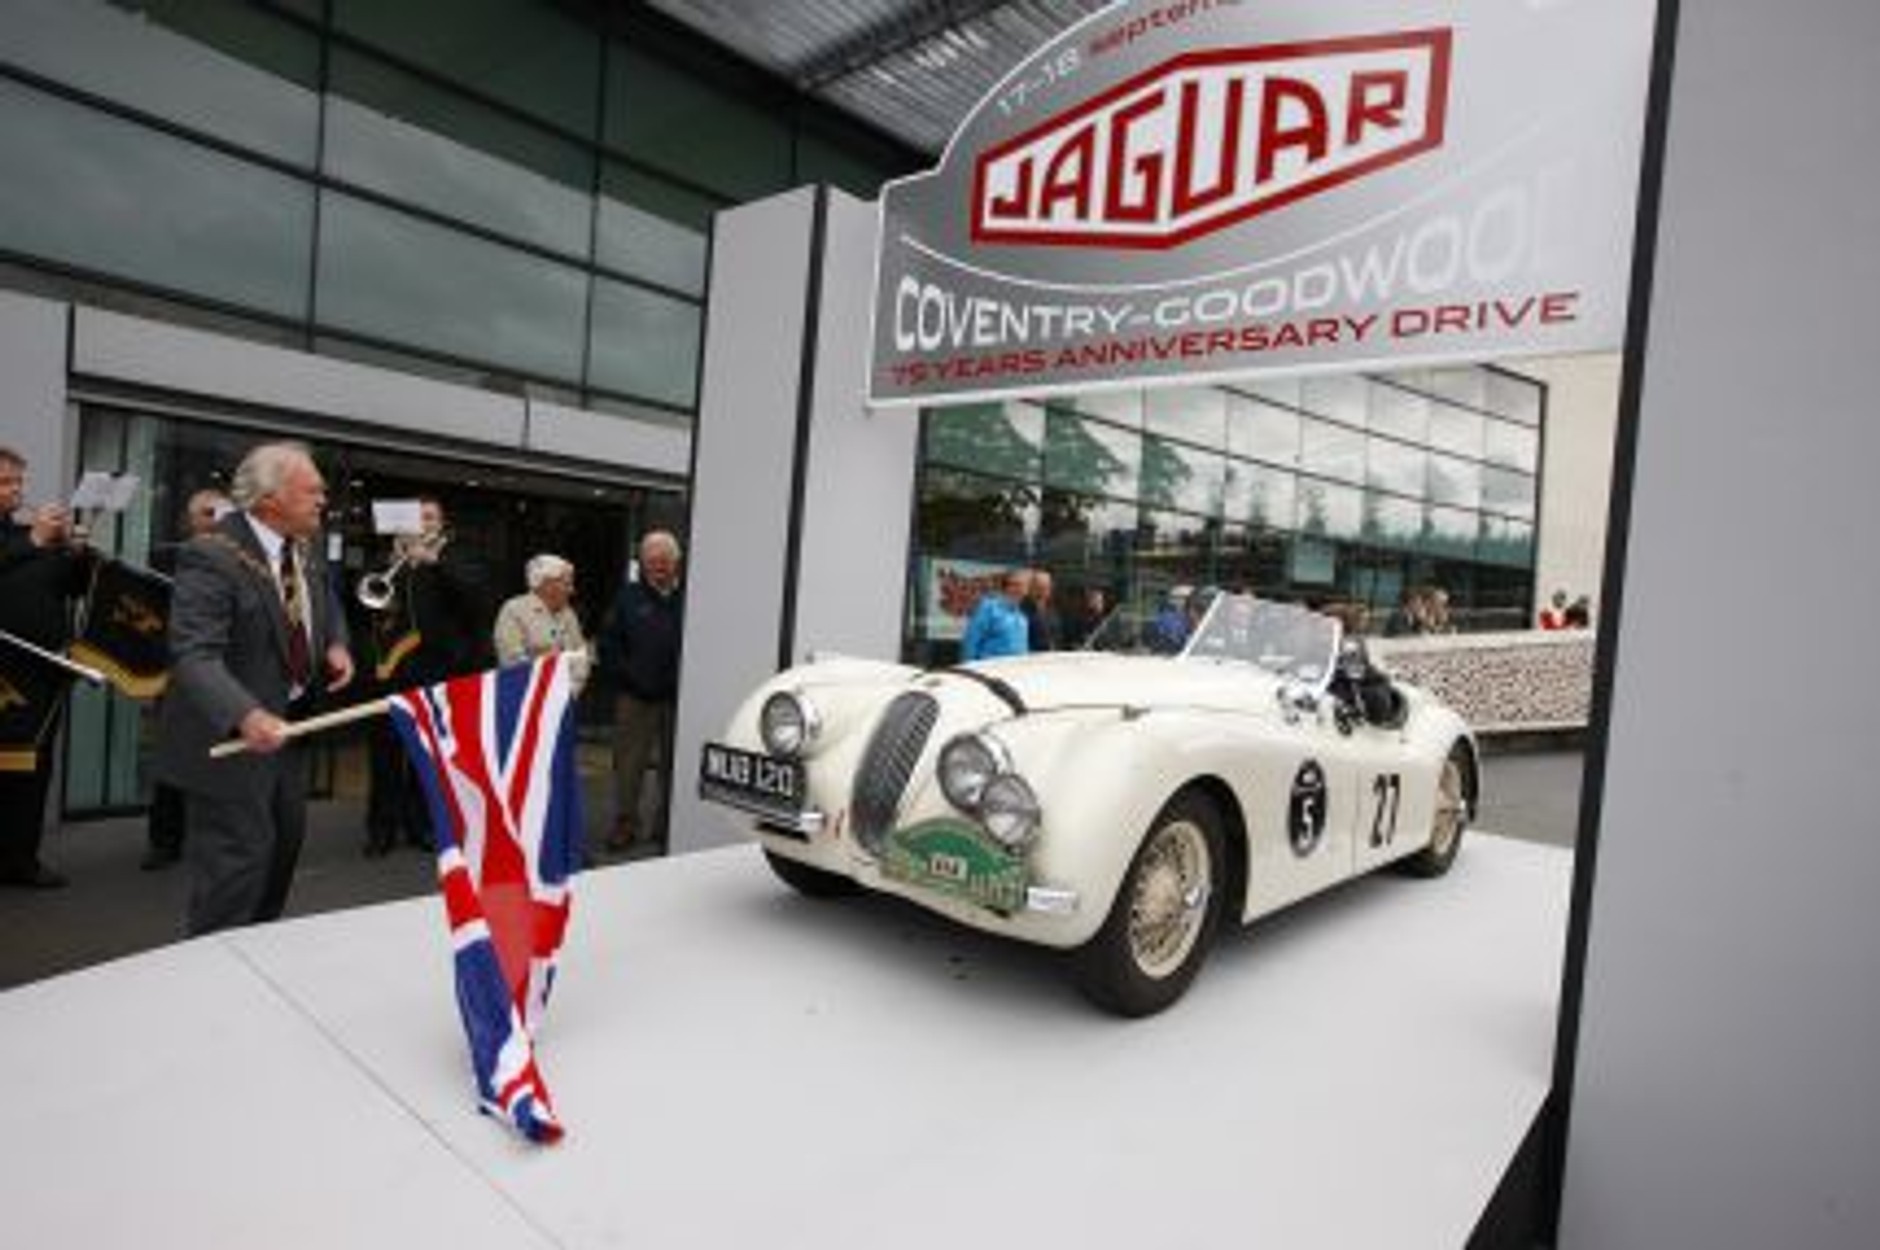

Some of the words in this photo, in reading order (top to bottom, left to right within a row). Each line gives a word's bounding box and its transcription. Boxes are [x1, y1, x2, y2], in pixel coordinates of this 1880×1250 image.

[989, 72, 1408, 224] JAGUAR
[930, 350, 1047, 380] YEARS
[1048, 315, 1378, 370] ANNIVERSARY
[1391, 292, 1581, 338] DRIVE
[1300, 797, 1316, 848] 5
[1370, 773, 1400, 848] 27
